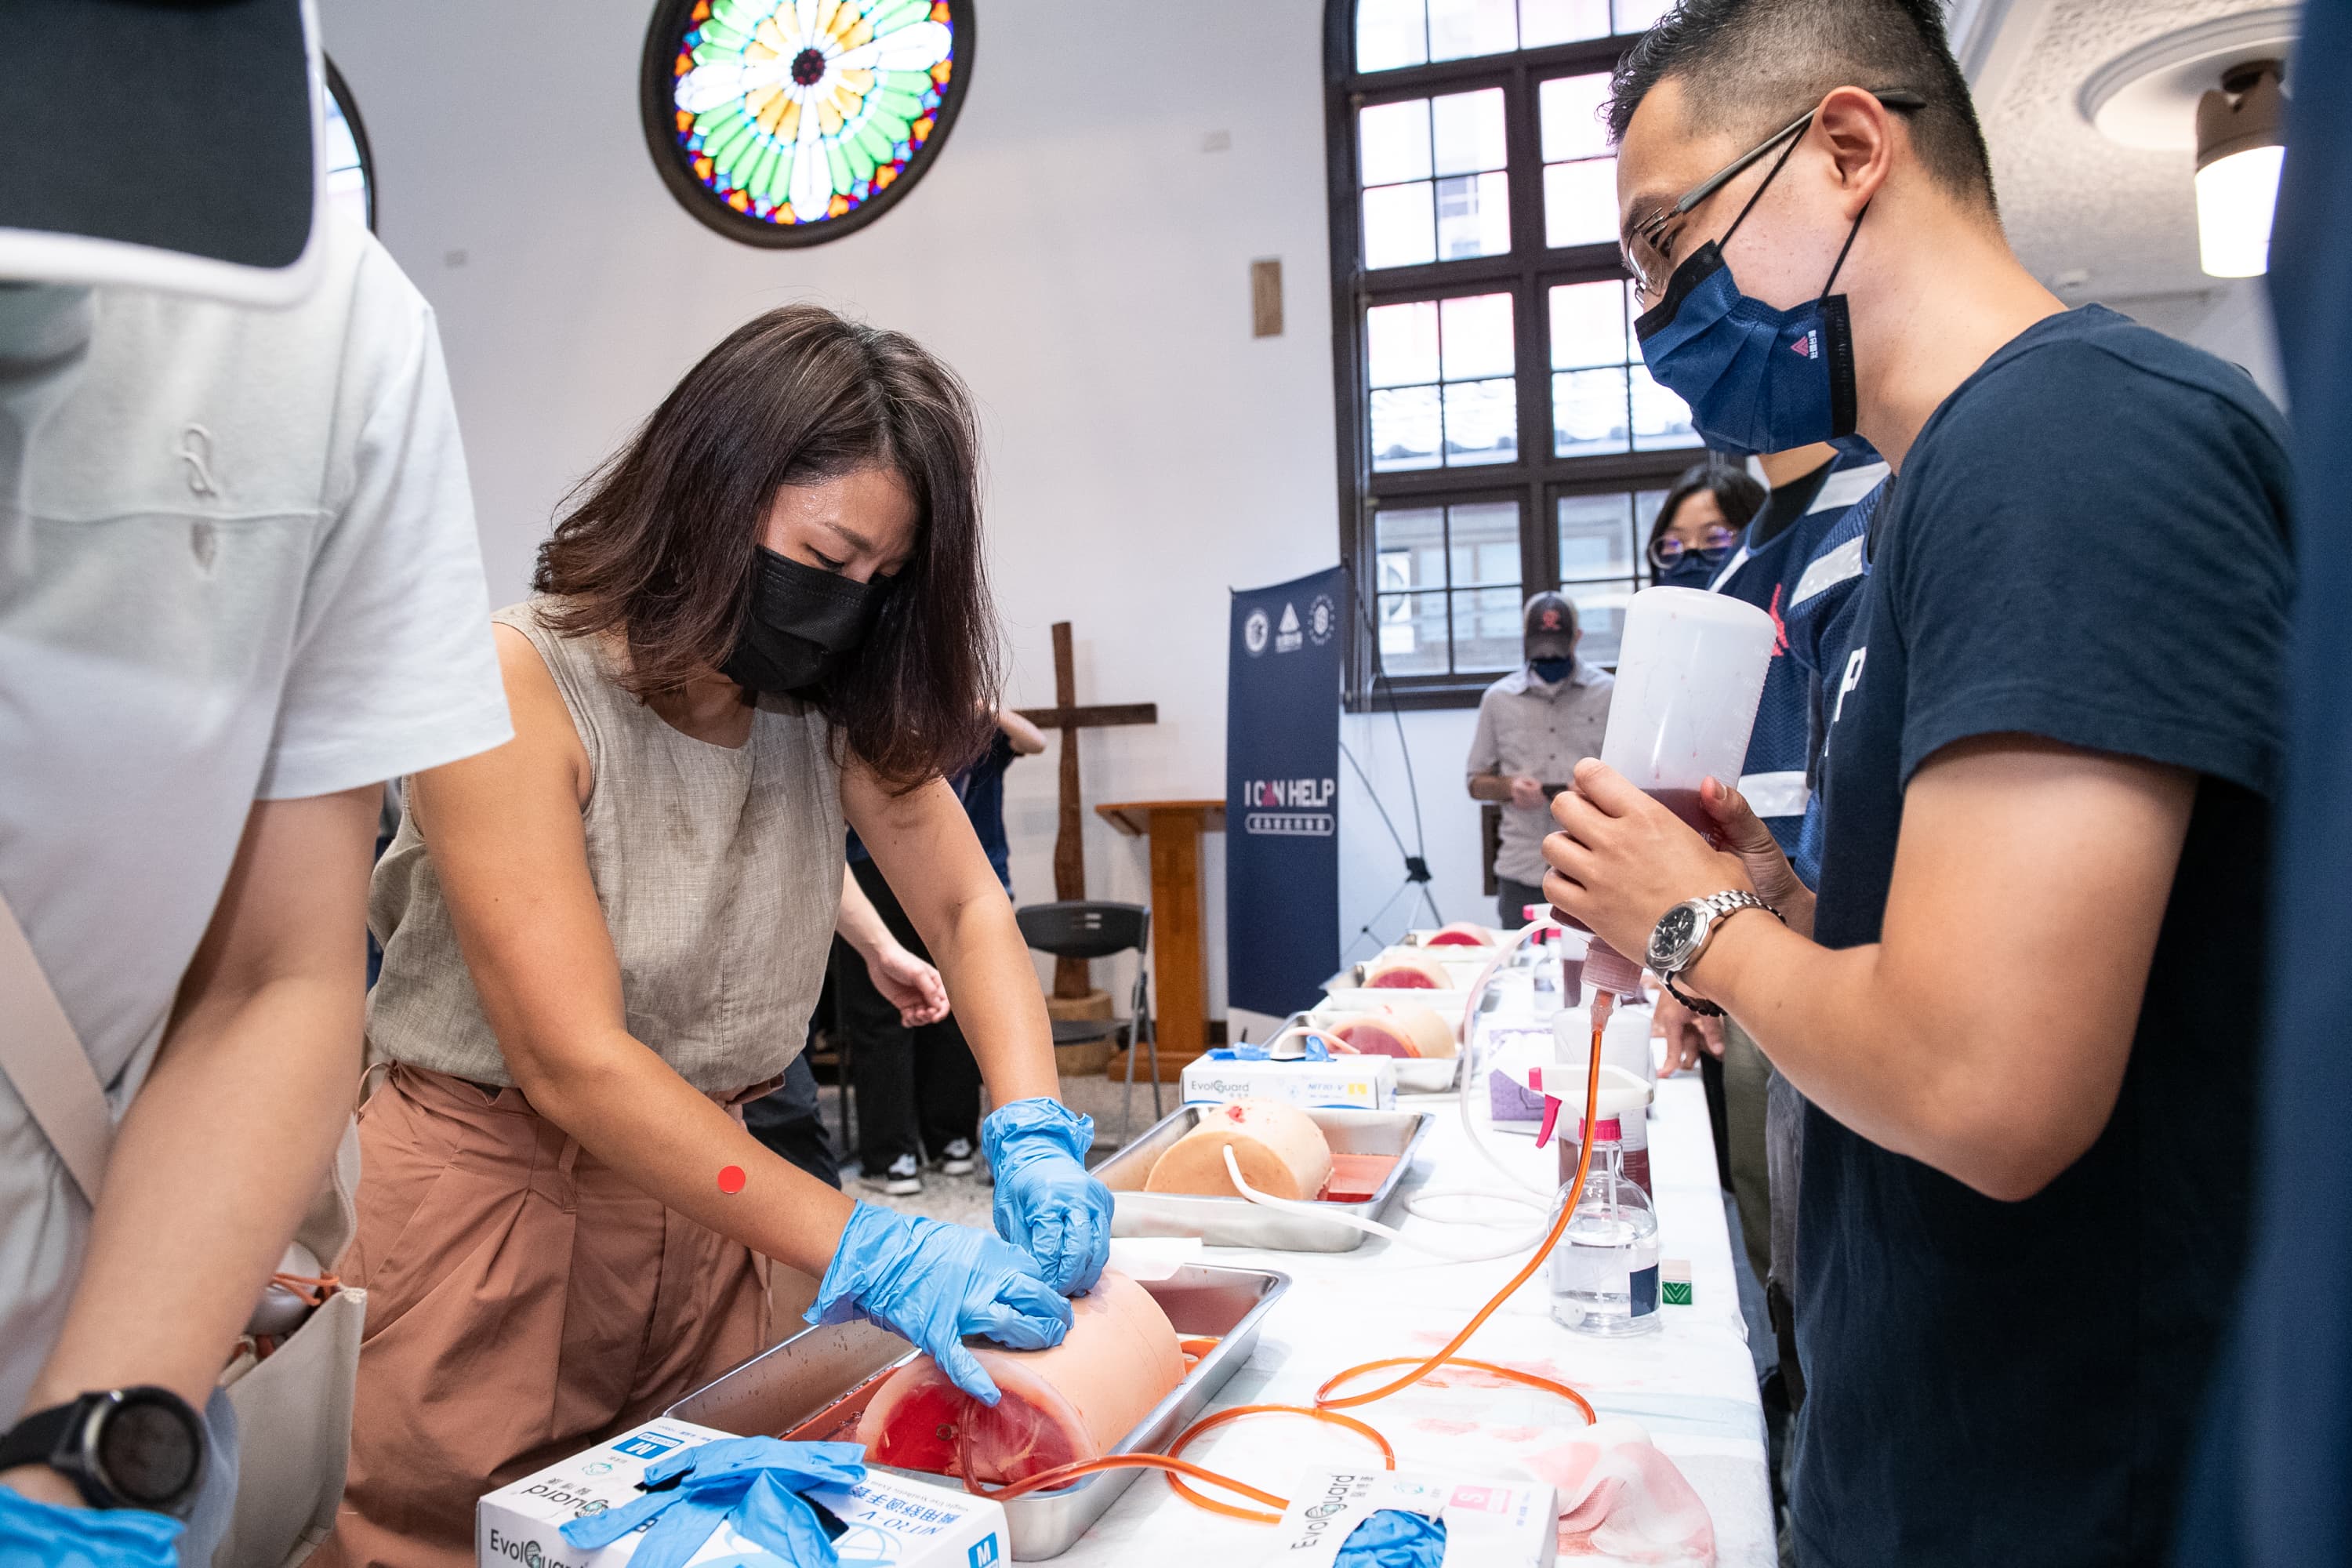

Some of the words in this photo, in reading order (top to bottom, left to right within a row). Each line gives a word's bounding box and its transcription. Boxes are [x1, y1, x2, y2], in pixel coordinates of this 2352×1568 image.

[1244, 781, 1250, 807] I
[1288, 779, 1335, 807] HELP
[625, 1441, 659, 1456] M
[1458, 1492, 1484, 1504] S
[976, 1540, 992, 1568] M
